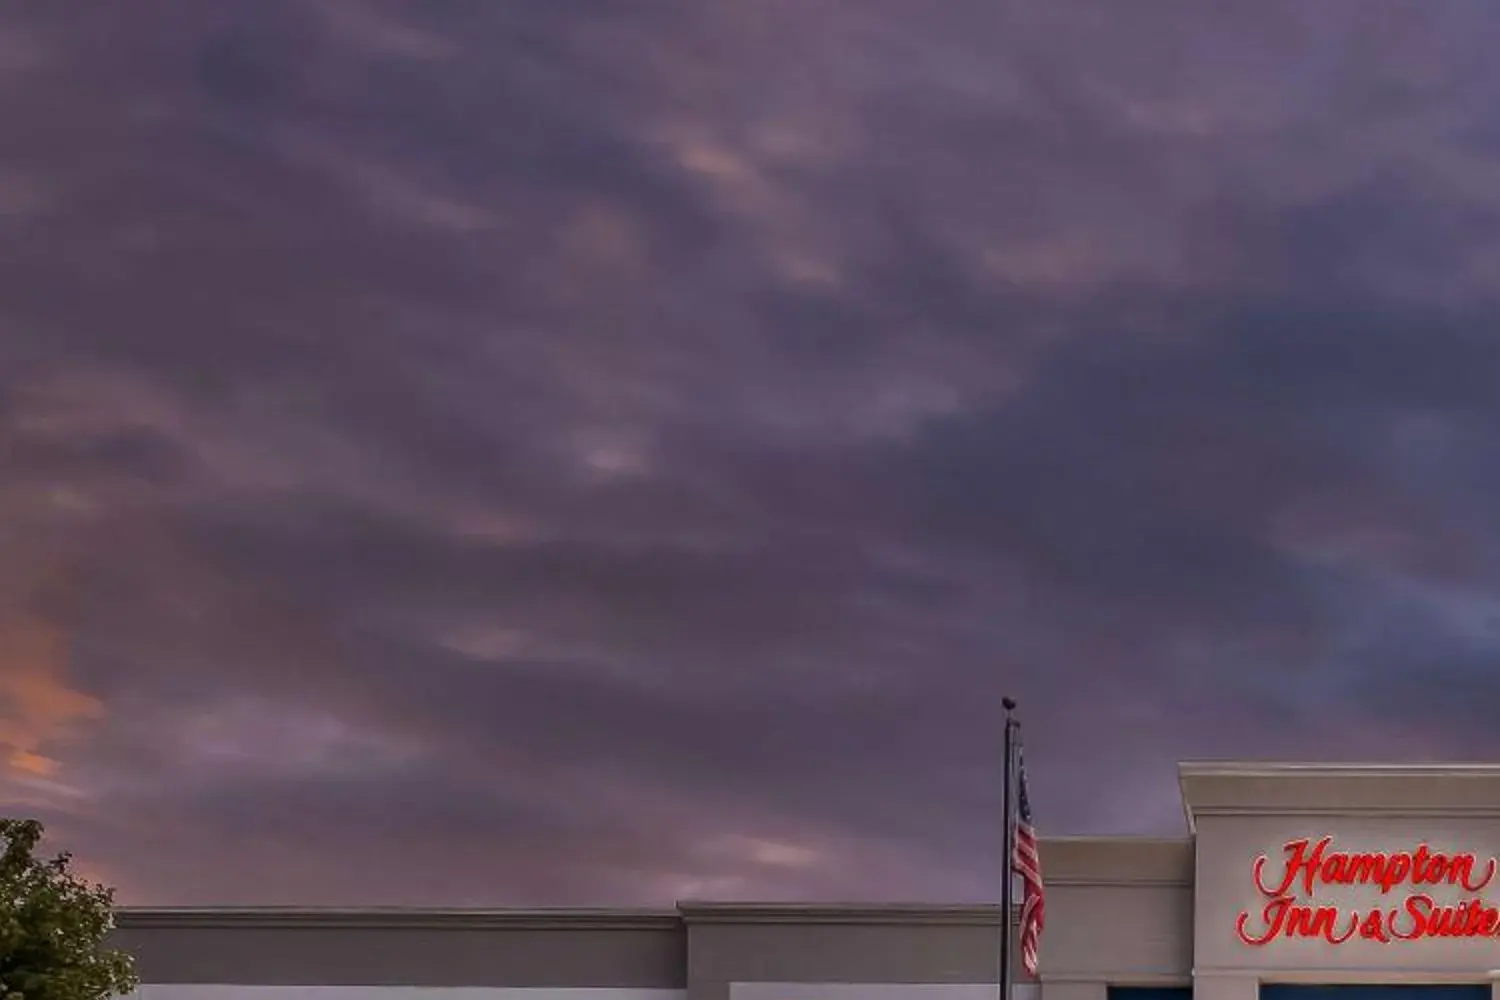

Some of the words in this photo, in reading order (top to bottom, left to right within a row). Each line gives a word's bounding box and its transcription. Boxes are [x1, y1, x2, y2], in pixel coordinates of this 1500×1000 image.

[1254, 835, 1496, 897] Hampton
[1236, 896, 1359, 945] Inn
[1359, 907, 1391, 944] &
